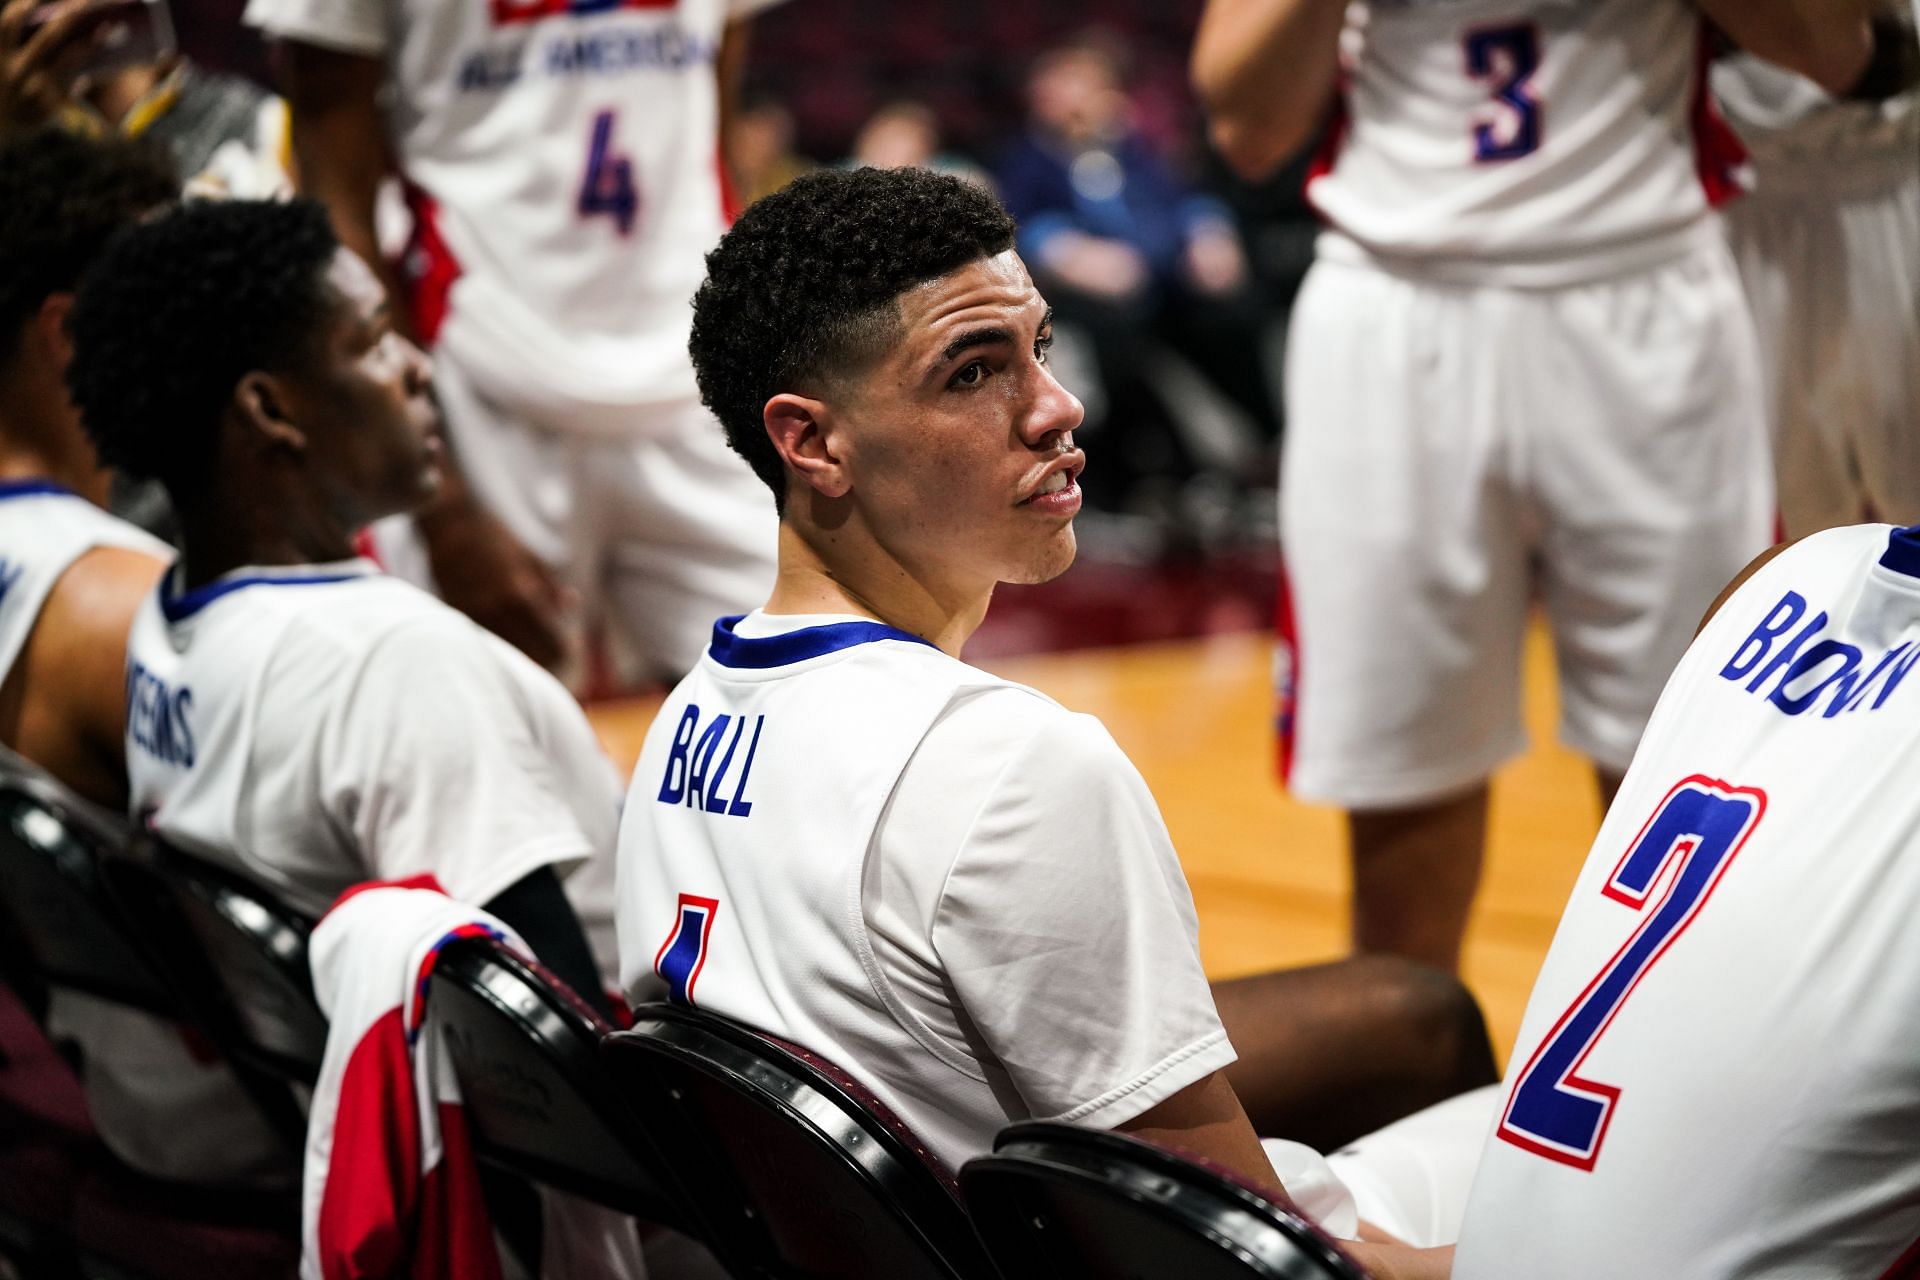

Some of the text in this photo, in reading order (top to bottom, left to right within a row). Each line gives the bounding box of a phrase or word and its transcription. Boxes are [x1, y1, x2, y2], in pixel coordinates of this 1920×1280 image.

[1459, 20, 1546, 166] 3
[576, 107, 643, 237] 4
[657, 704, 765, 818] BALL
[1496, 773, 1768, 1174] 2
